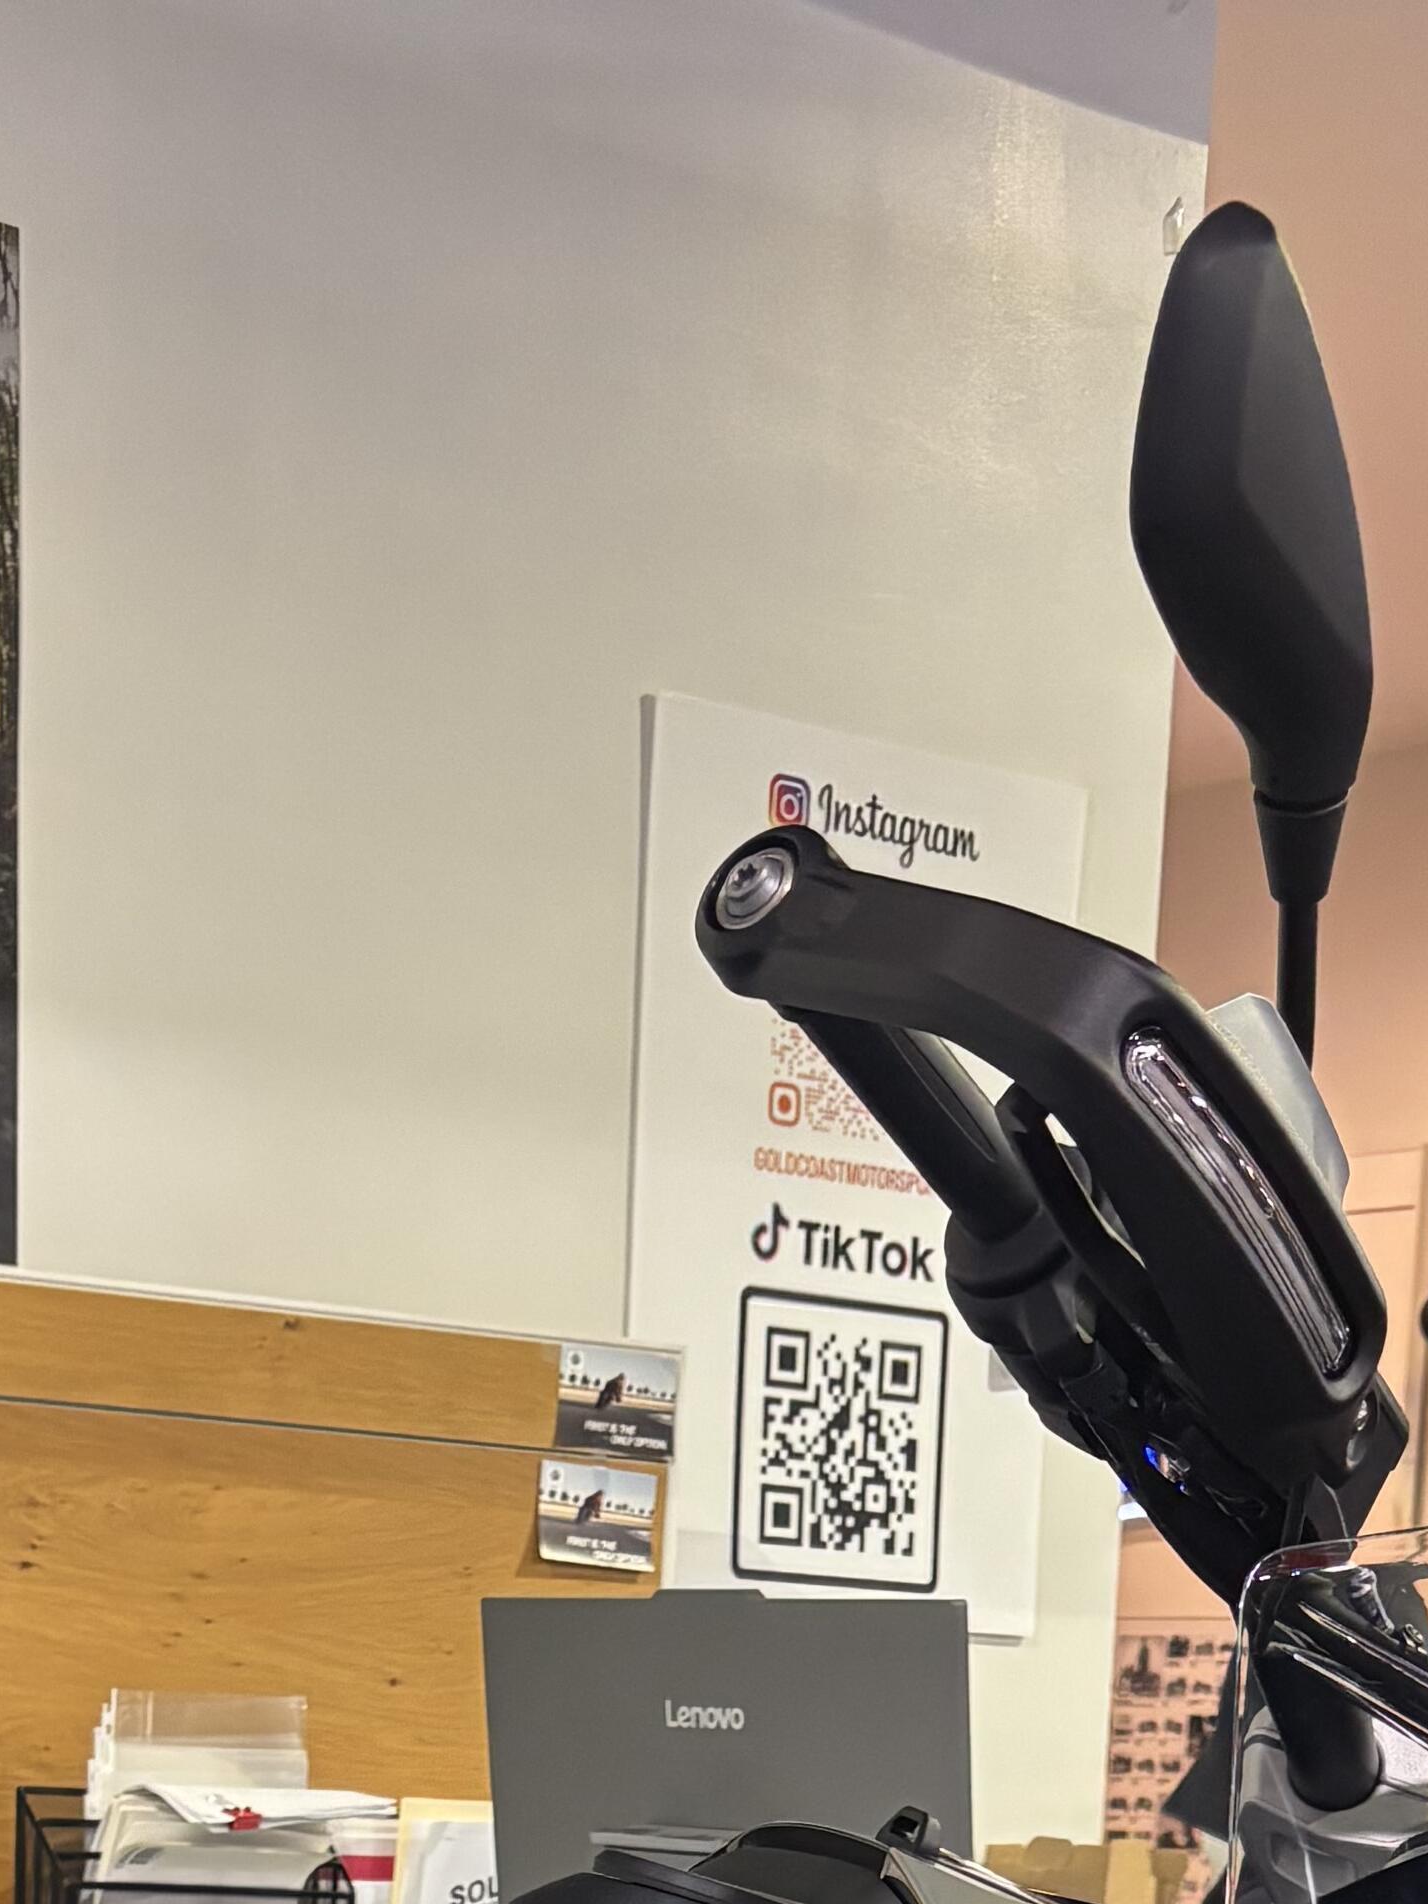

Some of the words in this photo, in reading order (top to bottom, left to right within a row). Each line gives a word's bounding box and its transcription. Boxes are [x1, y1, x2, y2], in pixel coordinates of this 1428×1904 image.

[819, 785, 980, 869] Instagram
[797, 1219, 934, 1283] TikTok
[665, 1699, 744, 1730] Lenovo
